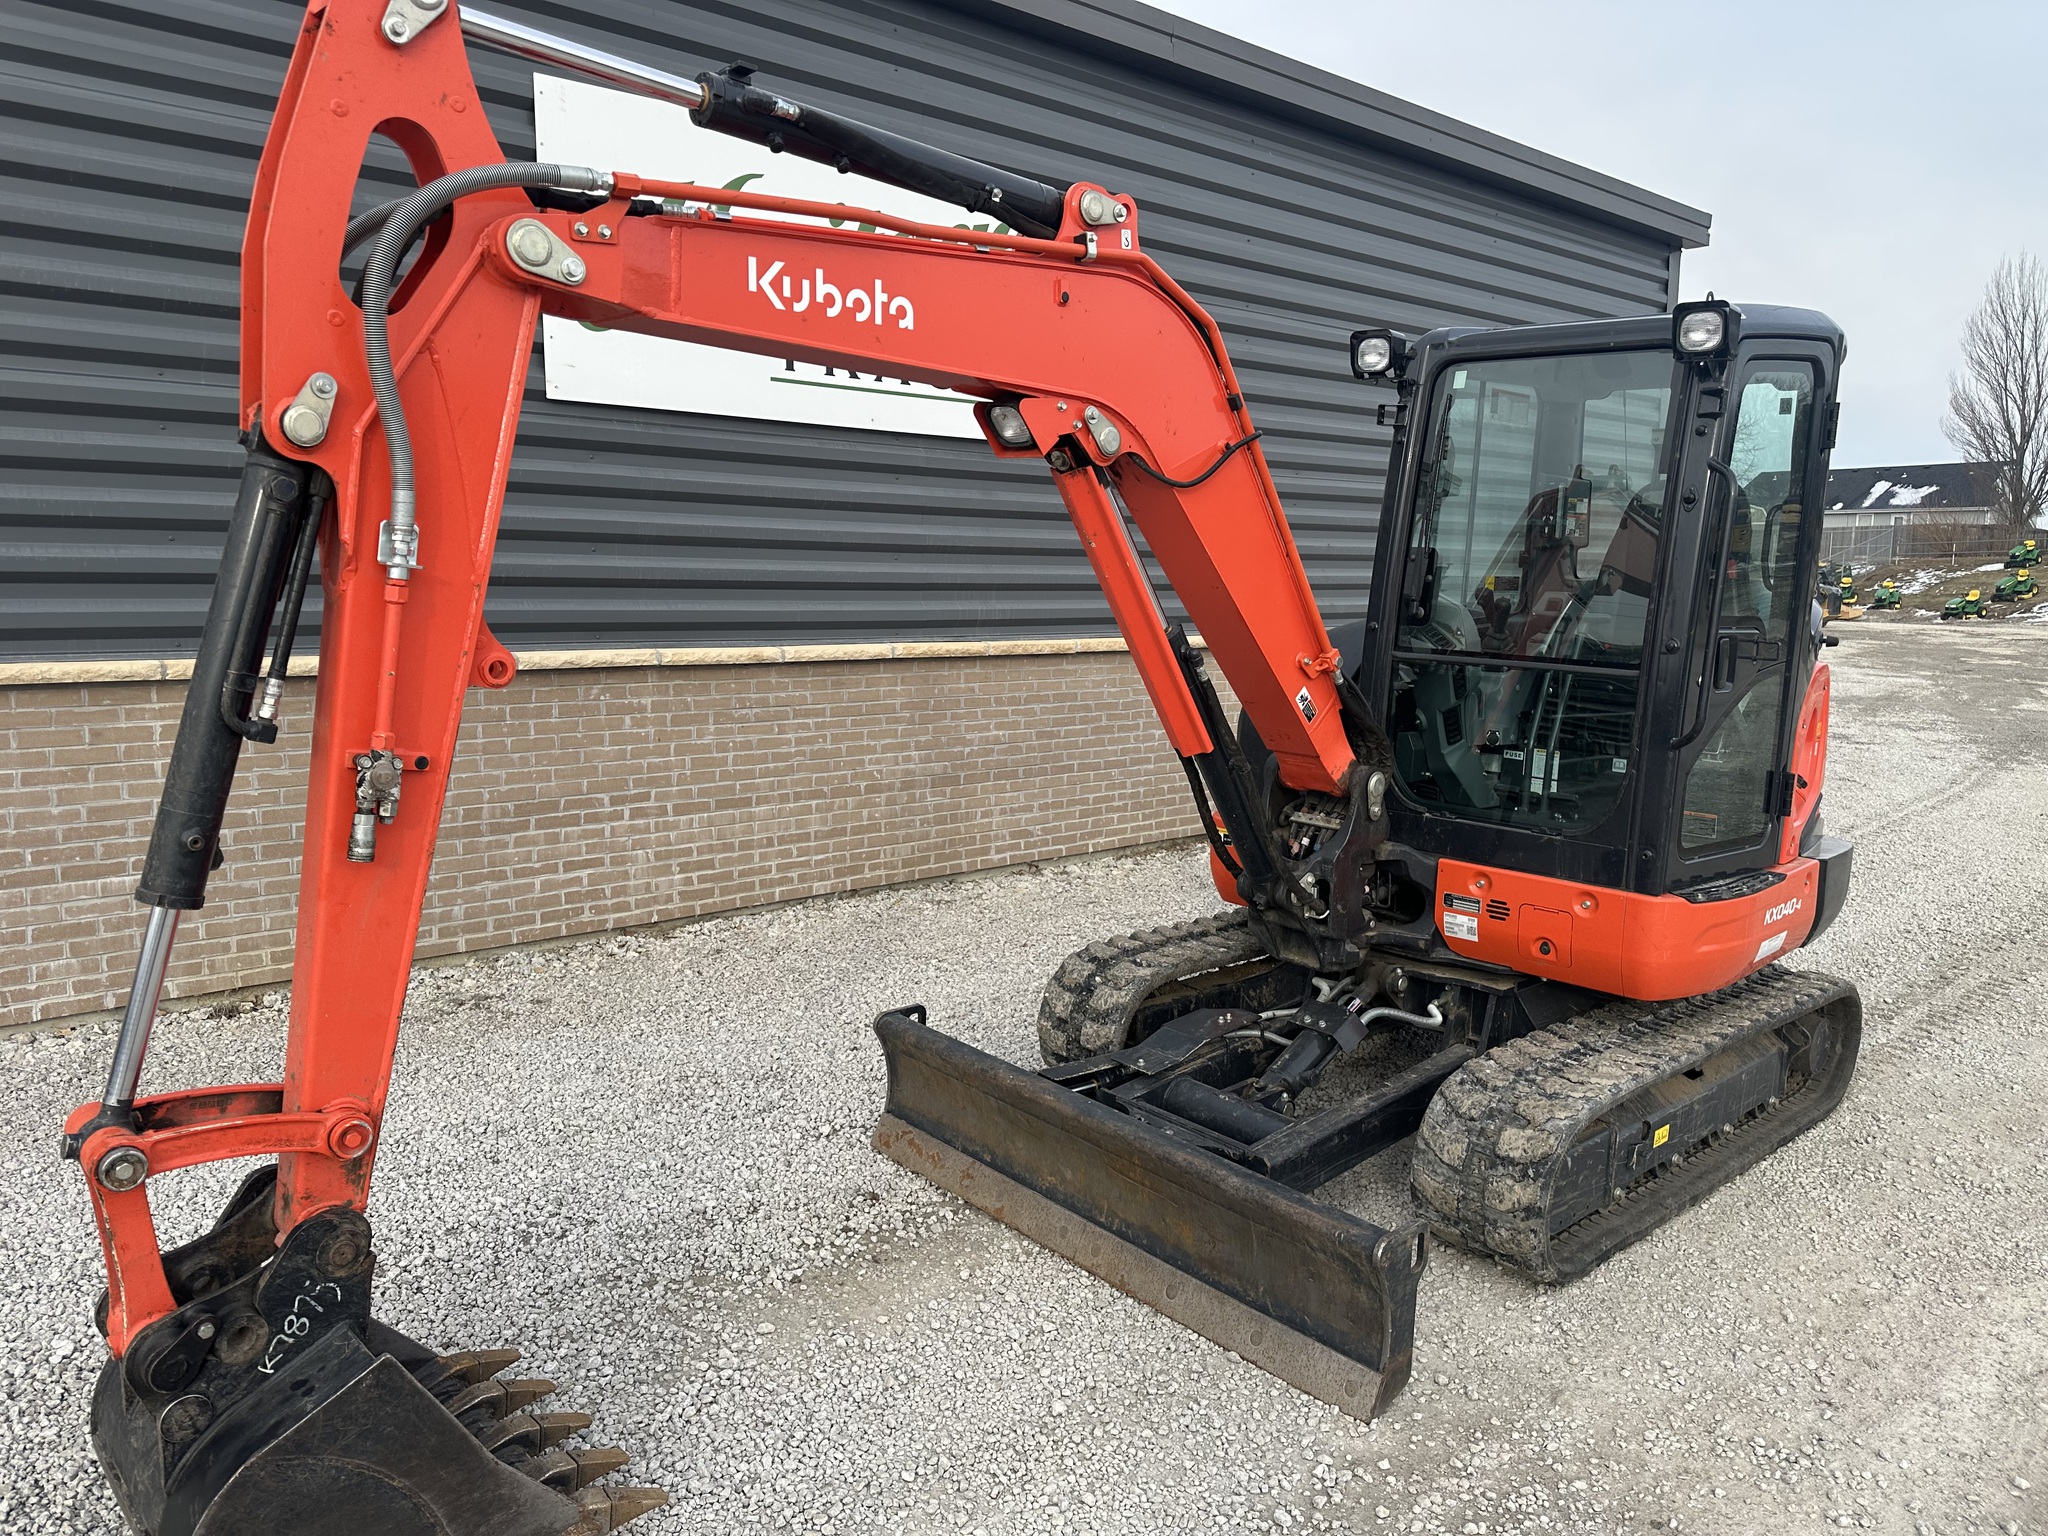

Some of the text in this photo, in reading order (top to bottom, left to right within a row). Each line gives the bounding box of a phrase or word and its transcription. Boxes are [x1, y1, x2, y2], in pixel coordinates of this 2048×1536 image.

[747, 255, 914, 331] Kubota
[1504, 750, 1523, 759] FUSE
[1763, 897, 1803, 926] KX040-4
